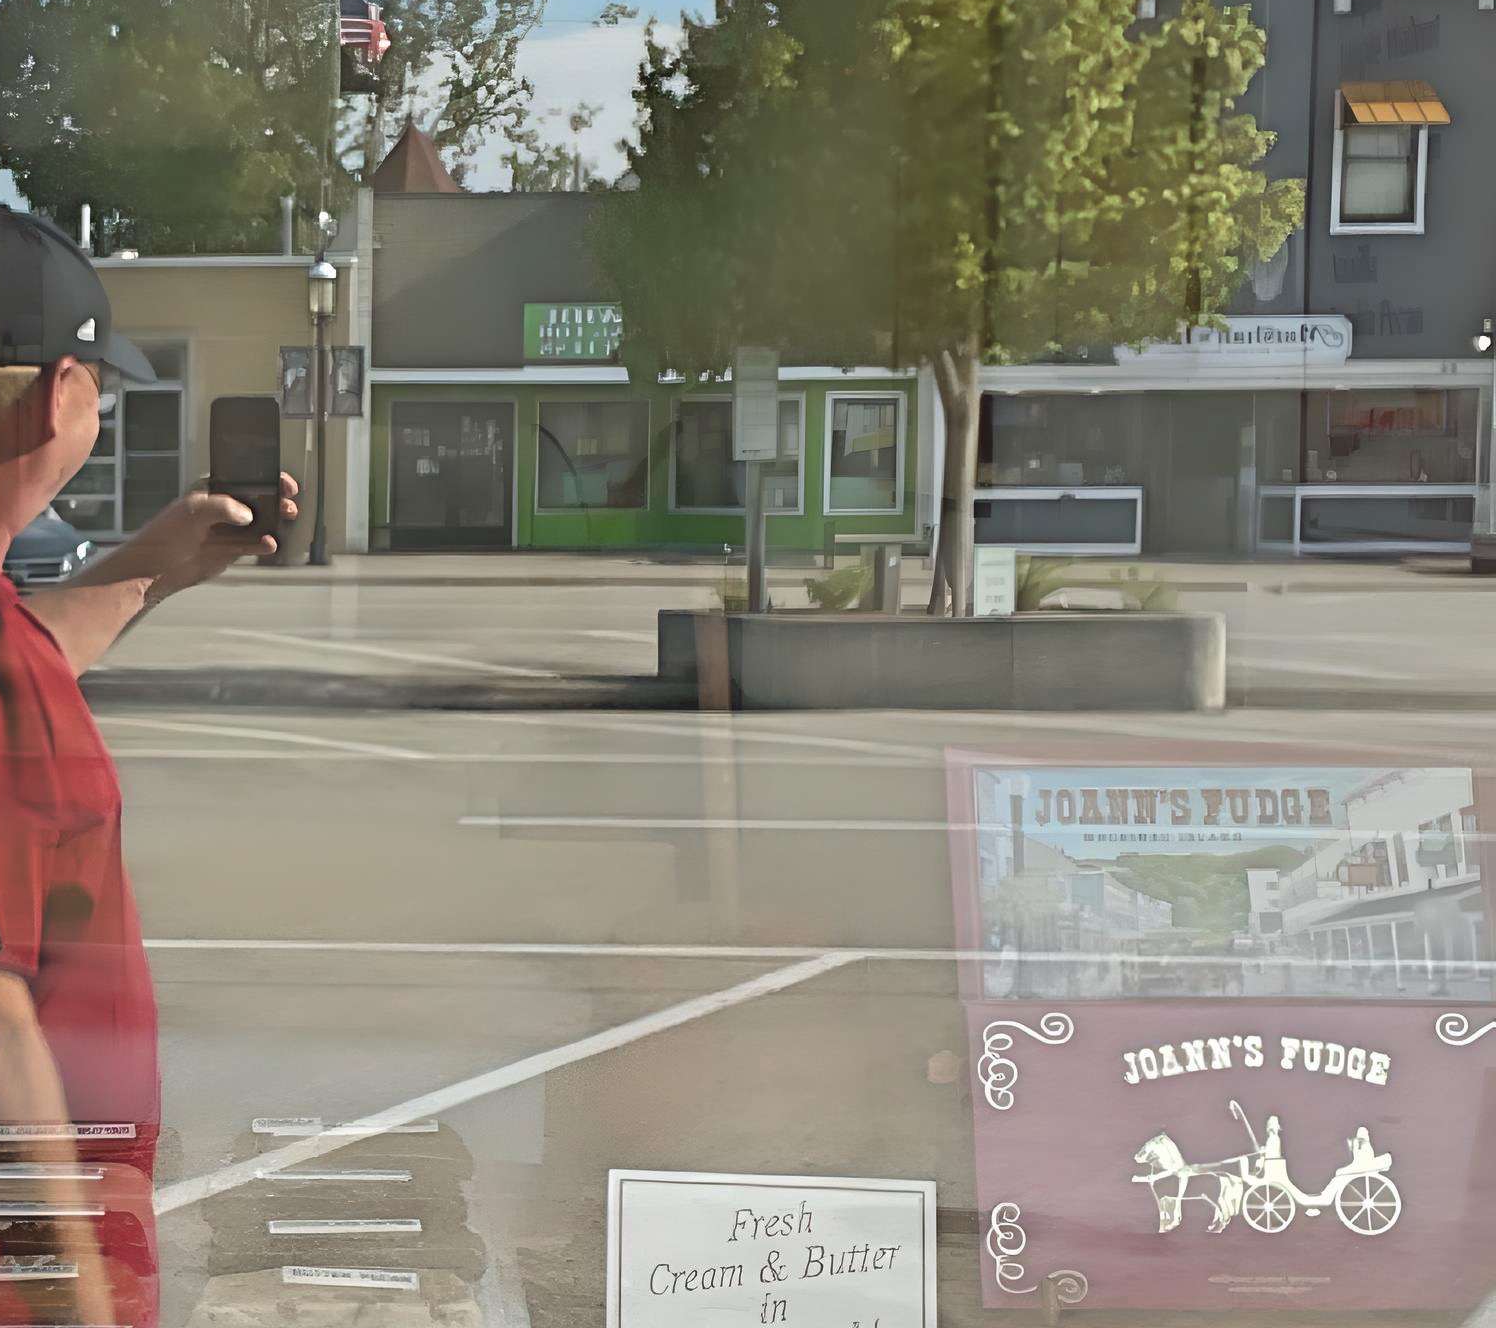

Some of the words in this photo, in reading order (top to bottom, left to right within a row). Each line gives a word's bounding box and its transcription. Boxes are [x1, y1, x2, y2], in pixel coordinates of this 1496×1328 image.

[1035, 787, 1192, 826] JOANN'S
[1200, 787, 1333, 825] FUDGE
[1124, 1035, 1264, 1085] JOANN'S
[1280, 1036, 1392, 1086] FUDGE
[728, 1200, 813, 1242] Fresh
[649, 1263, 744, 1296] Cream
[759, 1250, 789, 1284] &
[801, 1243, 903, 1280] Butter
[760, 1293, 787, 1324] in
